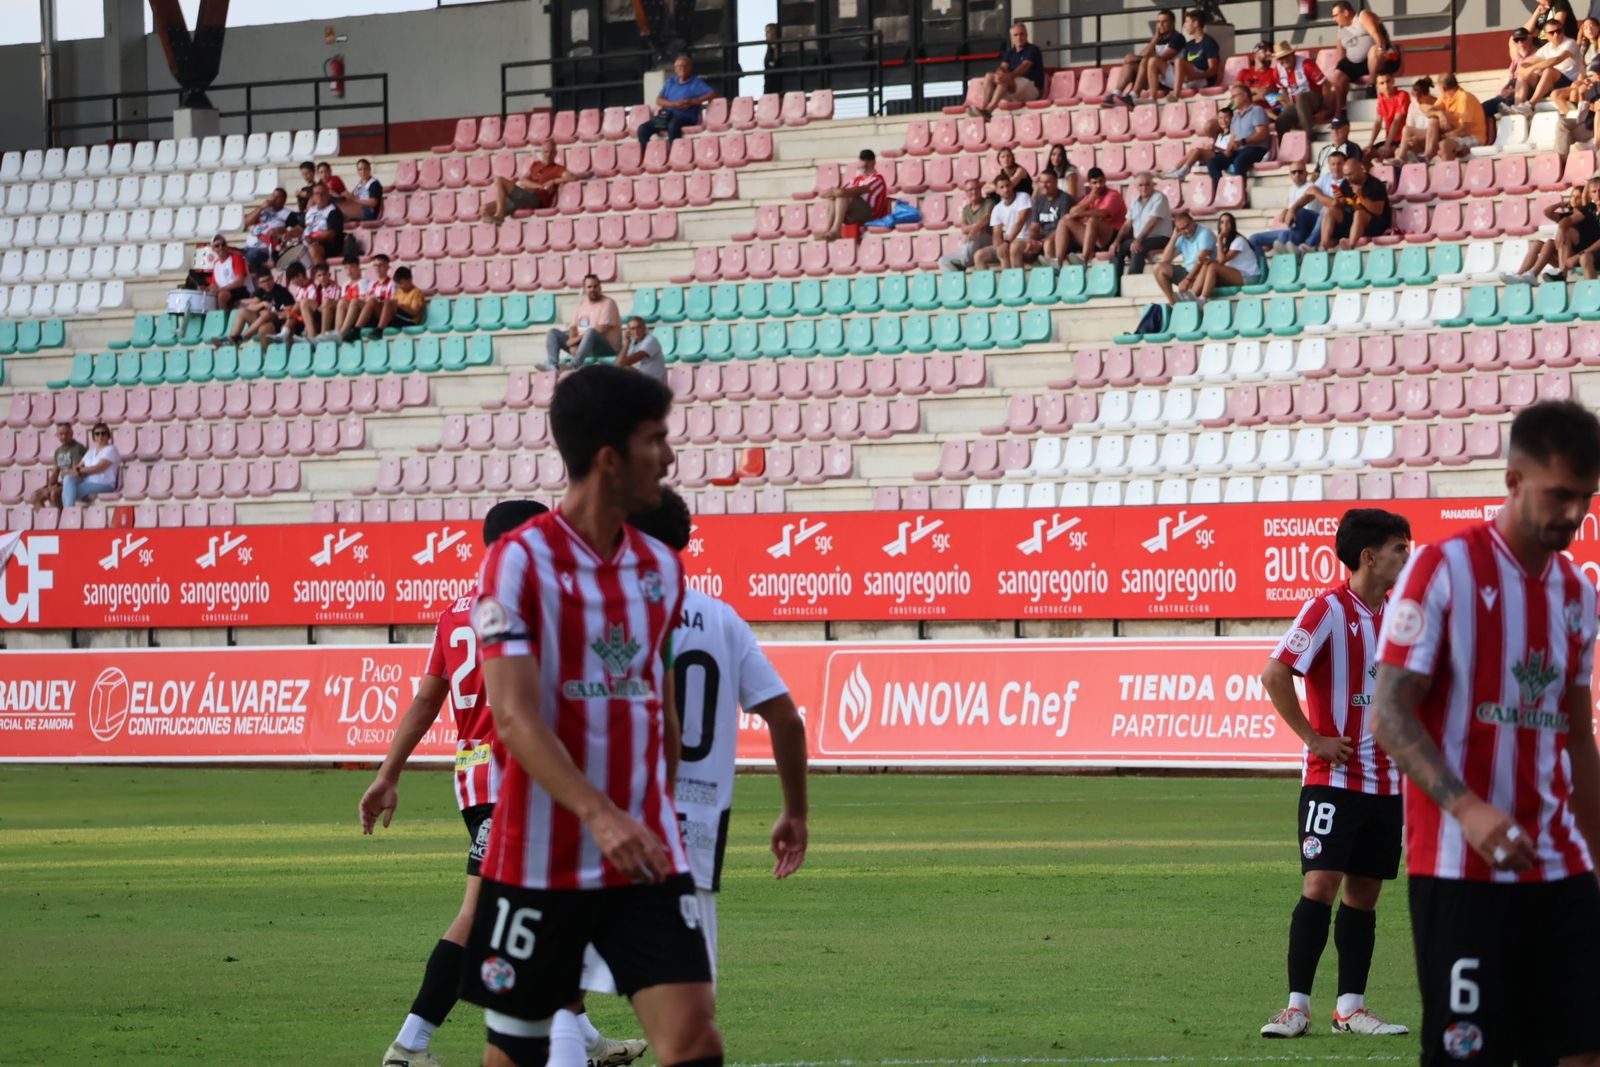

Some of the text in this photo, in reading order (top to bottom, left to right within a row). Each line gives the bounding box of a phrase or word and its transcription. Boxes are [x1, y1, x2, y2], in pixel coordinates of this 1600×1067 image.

[1441, 507, 1483, 520] PANADERÍA
[1195, 529, 1215, 549] sgc
[1264, 518, 1339, 536] DESGUACES
[352, 544, 369, 564] sgc
[456, 543, 473, 562] sgc
[815, 534, 833, 555] sgc
[931, 533, 950, 553] sgc
[1069, 531, 1088, 551] sgc
[139, 549, 154, 567] sgc
[237, 546, 253, 565] sgc
[180, 576, 270, 611] sangregorio
[293, 574, 386, 610] sangregorio
[748, 566, 852, 604] sangregorio
[864, 564, 971, 603] sangregorio
[998, 562, 1109, 602] sangregorio
[1121, 561, 1237, 601] sangregorio
[1266, 588, 1313, 600] RECICLADO
[83, 577, 170, 612] sangregorio
[361, 657, 403, 683] PAGO
[130, 672, 310, 714] ELOY ÁLVAREZ
[1118, 674, 1215, 701] TIENDA
[880, 680, 1080, 737] INNOVA Chef
[25, 718, 36, 730] DE
[38, 718, 74, 730] ZAMORA
[128, 713, 305, 736] CONTRUCCIONES METÁLICAS
[346, 726, 385, 747] QUESO
[1111, 713, 1276, 739] PARTICULARES
[1305, 800, 1336, 835] 18
[490, 897, 542, 960] 16
[1450, 957, 1480, 1014] 6
